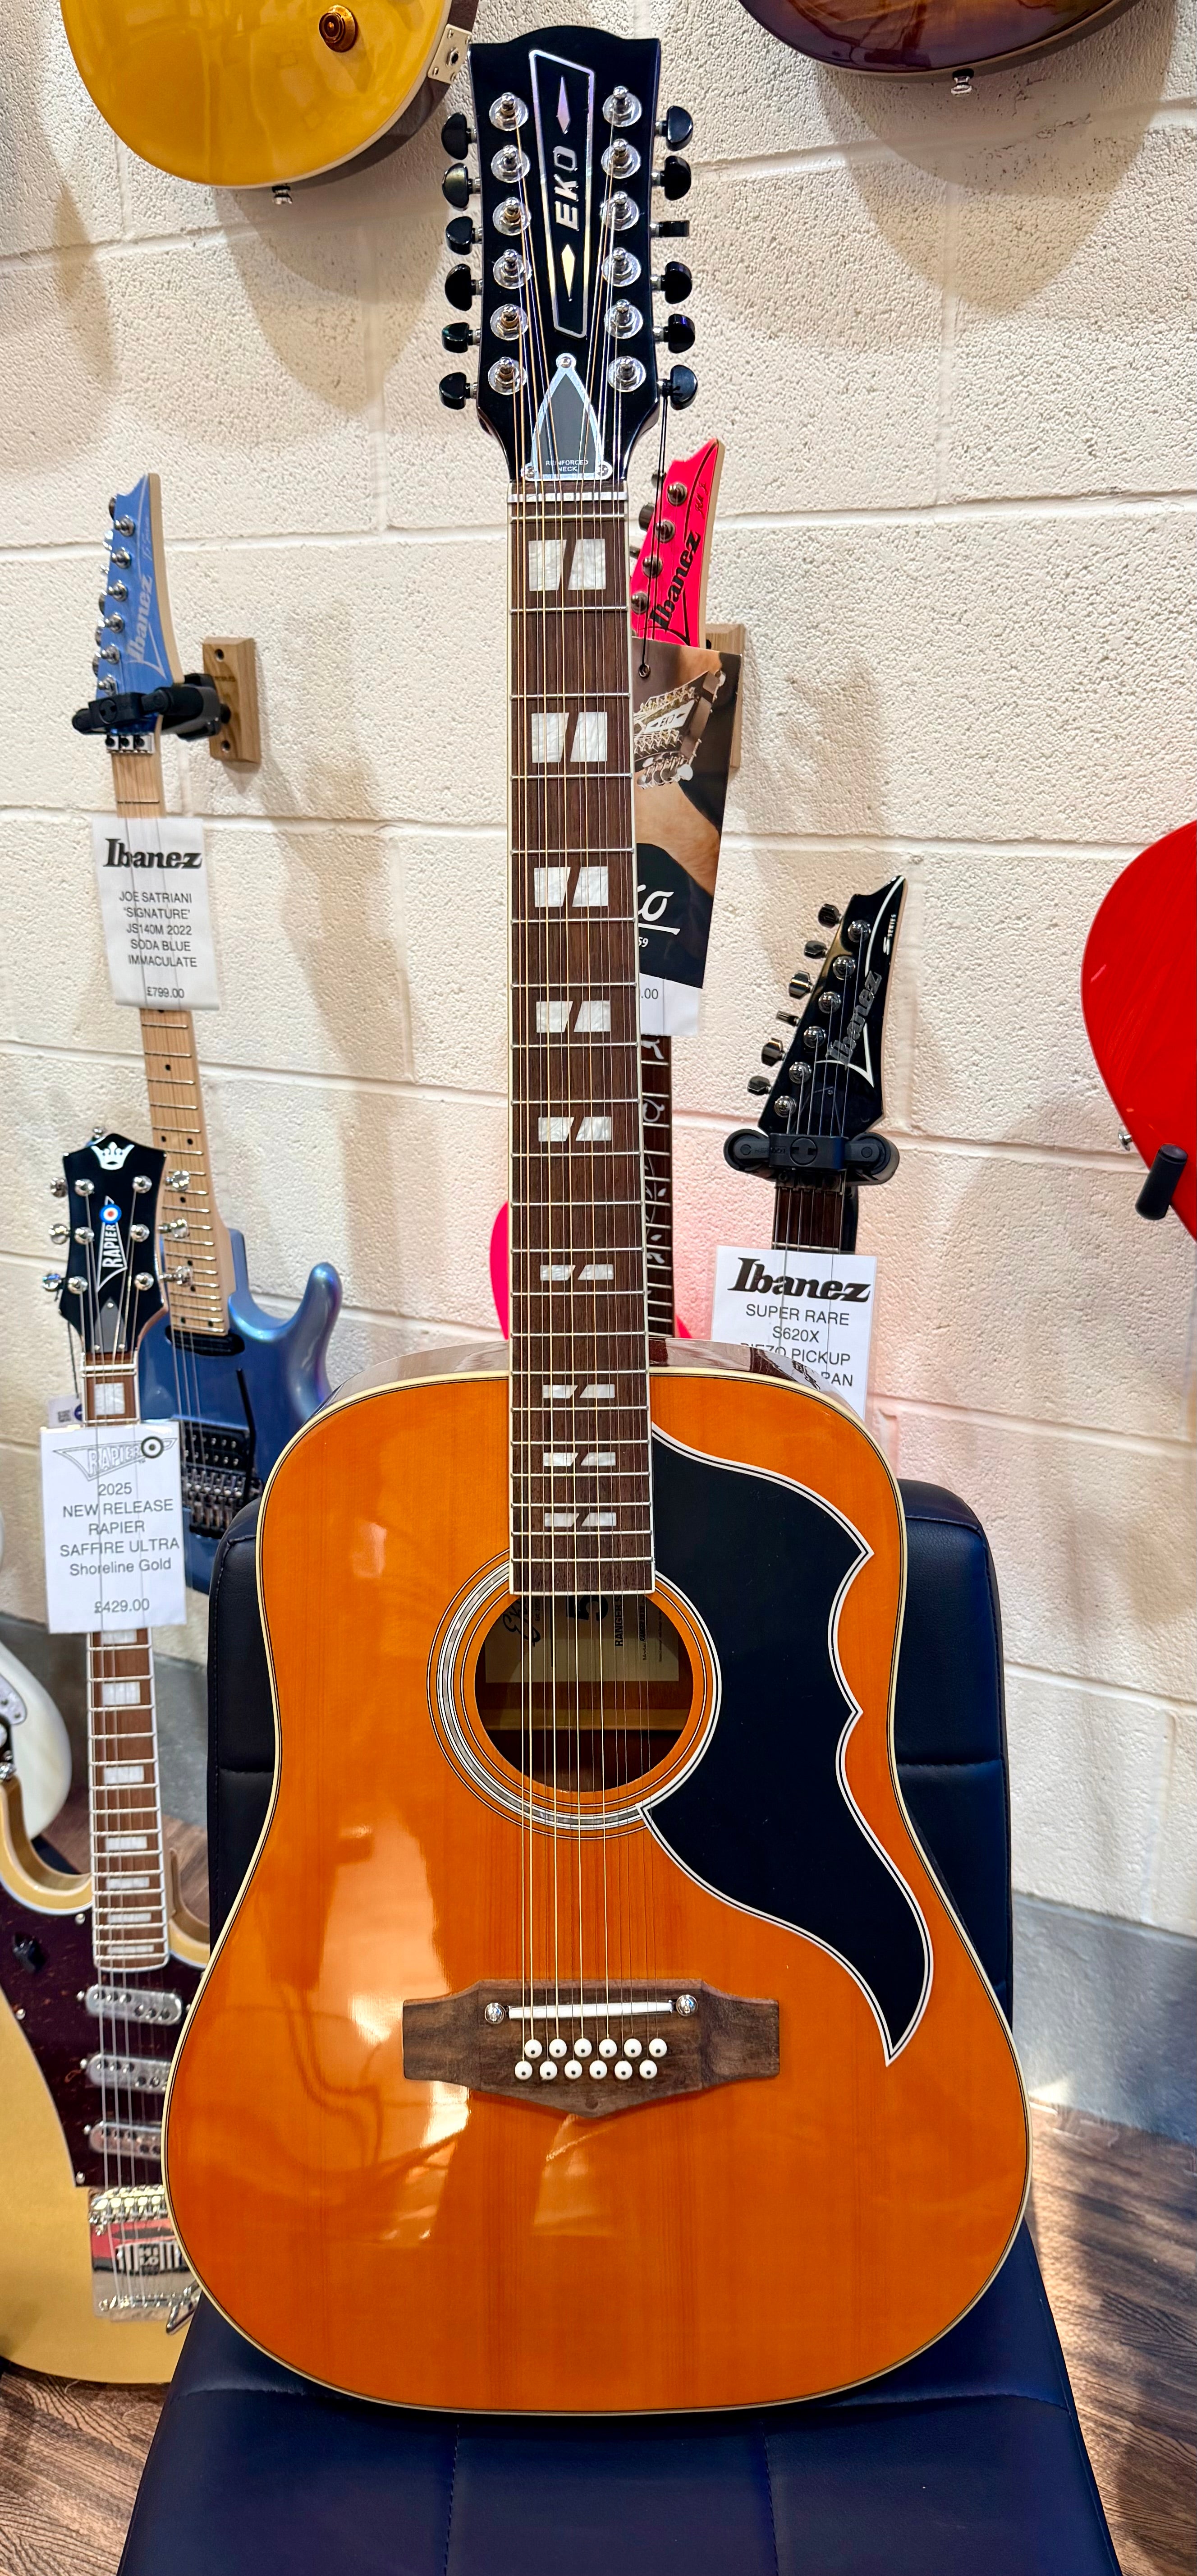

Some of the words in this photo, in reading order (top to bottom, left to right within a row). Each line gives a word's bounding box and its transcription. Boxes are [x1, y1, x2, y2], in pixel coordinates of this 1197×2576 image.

[553, 146, 579, 230] EKO
[650, 529, 701, 630] Ibanez
[127, 574, 152, 662] Ibanez
[103, 838, 202, 869] Ibanez
[119, 891, 139, 902] JOE
[142, 892, 192, 903] SATRIANI
[126, 923, 164, 935] JS140M
[167, 925, 192, 936] 2022
[887, 914, 896, 937] SERIES
[131, 939, 158, 951] SODA
[162, 941, 191, 952] BLUE
[638, 936, 648, 948] 59
[128, 955, 197, 968] IMMACULATE
[147, 986, 185, 998] £799.00
[826, 970, 882, 1068] Ibanez
[102, 1224, 124, 1268] RAPIER
[727, 1257, 871, 1302] Ibanez
[746, 1303, 799, 1321] SUPER
[805, 1309, 850, 1326] RARE
[772, 1325, 820, 1343] S620X
[791, 1348, 851, 1366] PICKUP
[821, 1371, 853, 1387] PAN
[87, 1445, 141, 1477] RAPIER
[98, 1482, 132, 1496] 2025
[63, 1504, 99, 1518] NEW
[103, 1499, 173, 1514] RELEASE
[89, 1520, 145, 1535] RAPIER
[60, 1540, 124, 1557] SAFFIRE
[129, 1537, 179, 1553] ULTRA
[70, 1559, 134, 1576] Shoreline
[139, 1557, 171, 1572] Gold
[94, 1598, 150, 1614] £429.00
[615, 1605, 624, 1647] RANGER
